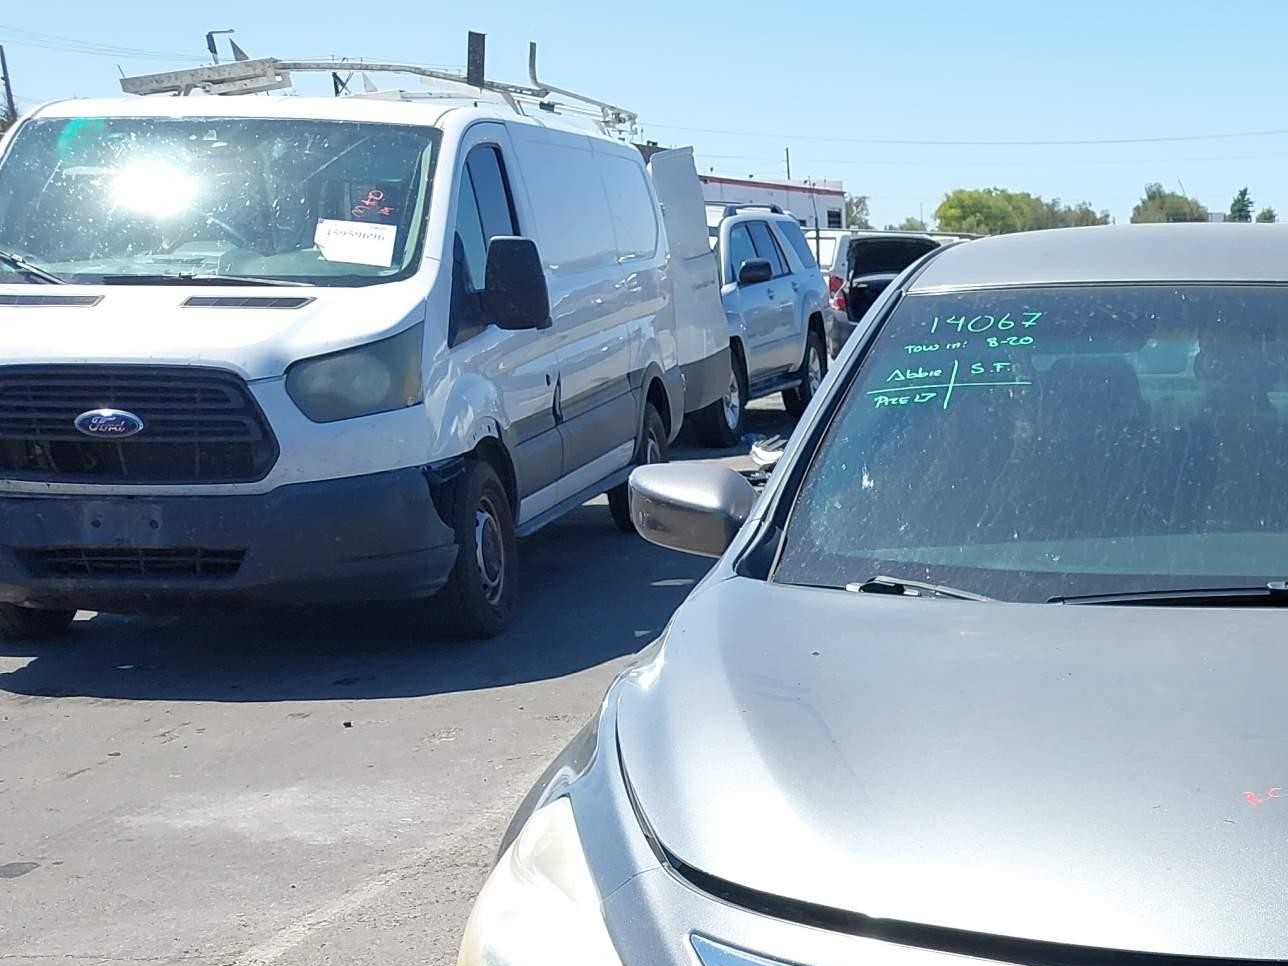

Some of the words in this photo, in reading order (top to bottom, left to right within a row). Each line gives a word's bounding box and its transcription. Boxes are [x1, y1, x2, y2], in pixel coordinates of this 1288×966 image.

[930, 312, 1042, 334] 14067
[986, 336, 1034, 348] 8-20
[88, 416, 127, 433] Ford
